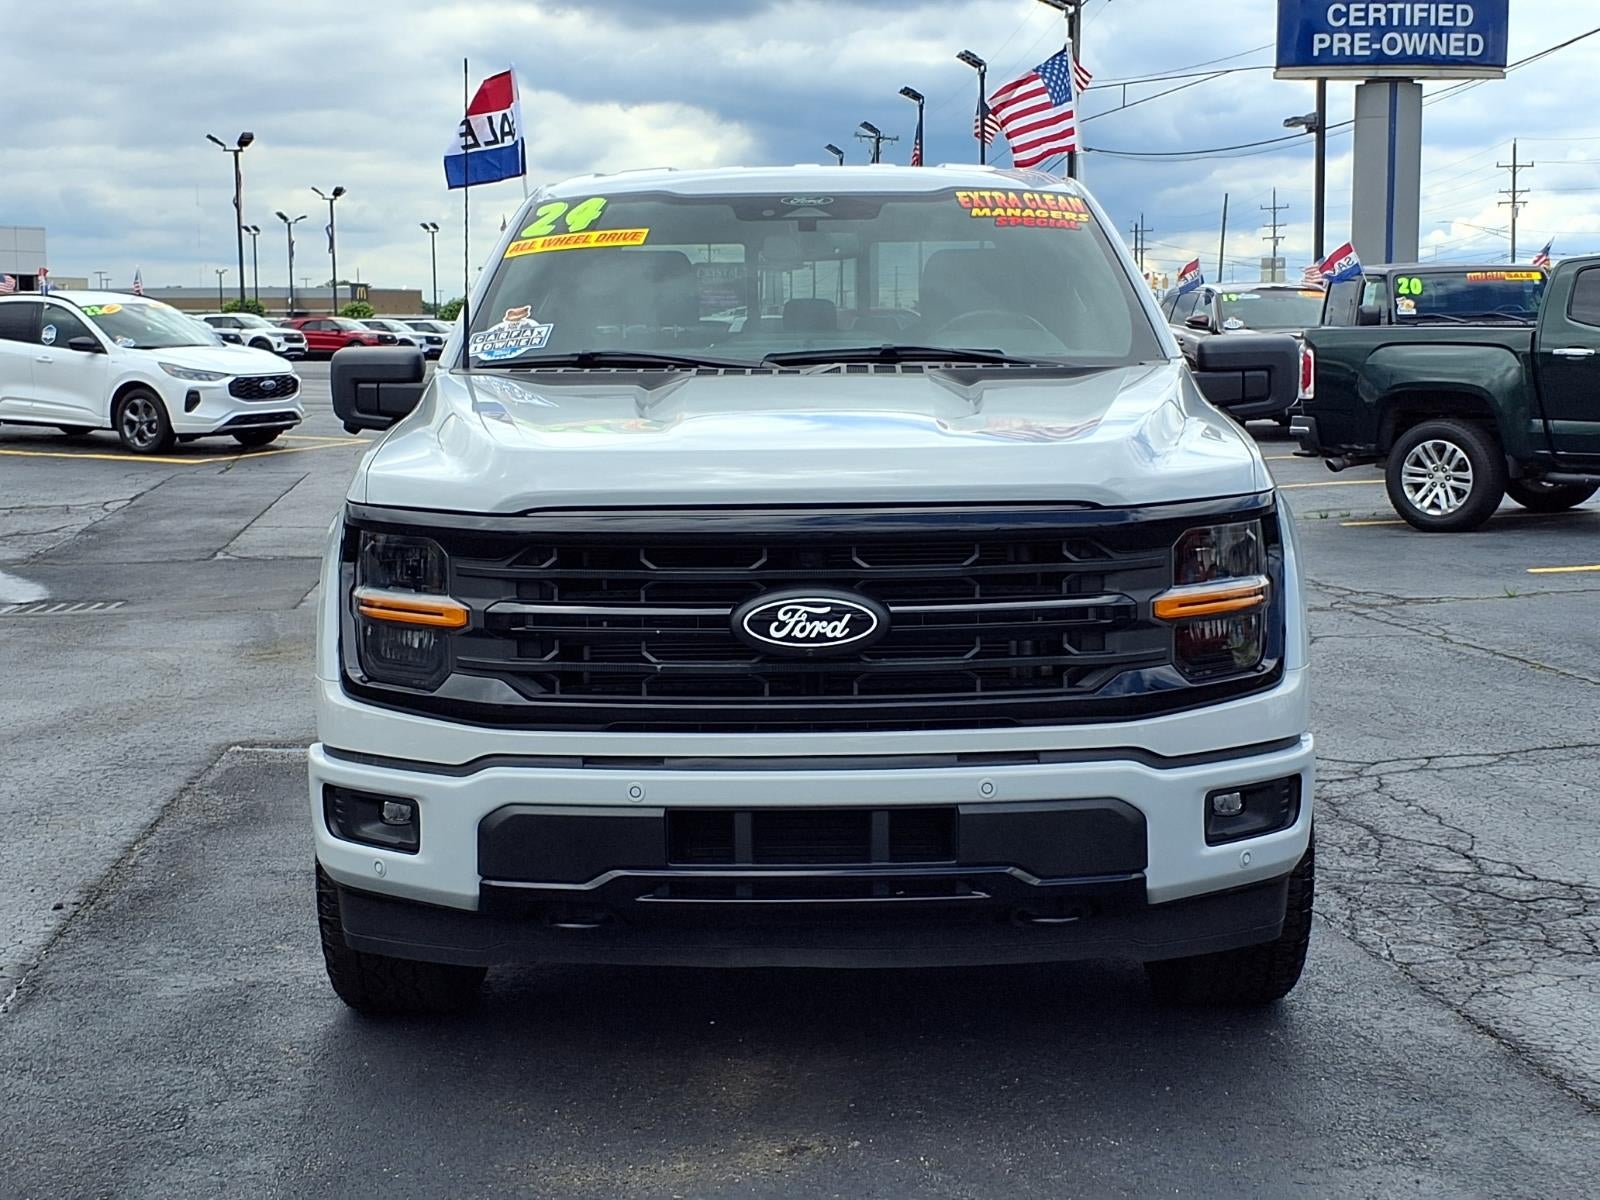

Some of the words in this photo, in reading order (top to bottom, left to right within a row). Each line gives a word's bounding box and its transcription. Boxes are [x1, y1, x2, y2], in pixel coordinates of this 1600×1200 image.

[1326, 3, 1474, 27] CERTIFIED
[1312, 32, 1484, 57] PRE-OWNED
[955, 190, 1022, 208] EXTRA
[1022, 192, 1085, 213] CLEAN
[521, 197, 608, 238] 24
[971, 207, 1089, 222] MANAGERS
[995, 217, 1082, 230] SPECIAL
[509, 241, 538, 255] ALL
[540, 234, 591, 249] WHEEL
[595, 231, 646, 243] DRIVE
[1396, 276, 1423, 296] 20
[474, 328, 545, 344] CARFAX
[483, 337, 542, 351] OWNER
[769, 605, 853, 638] Ford
